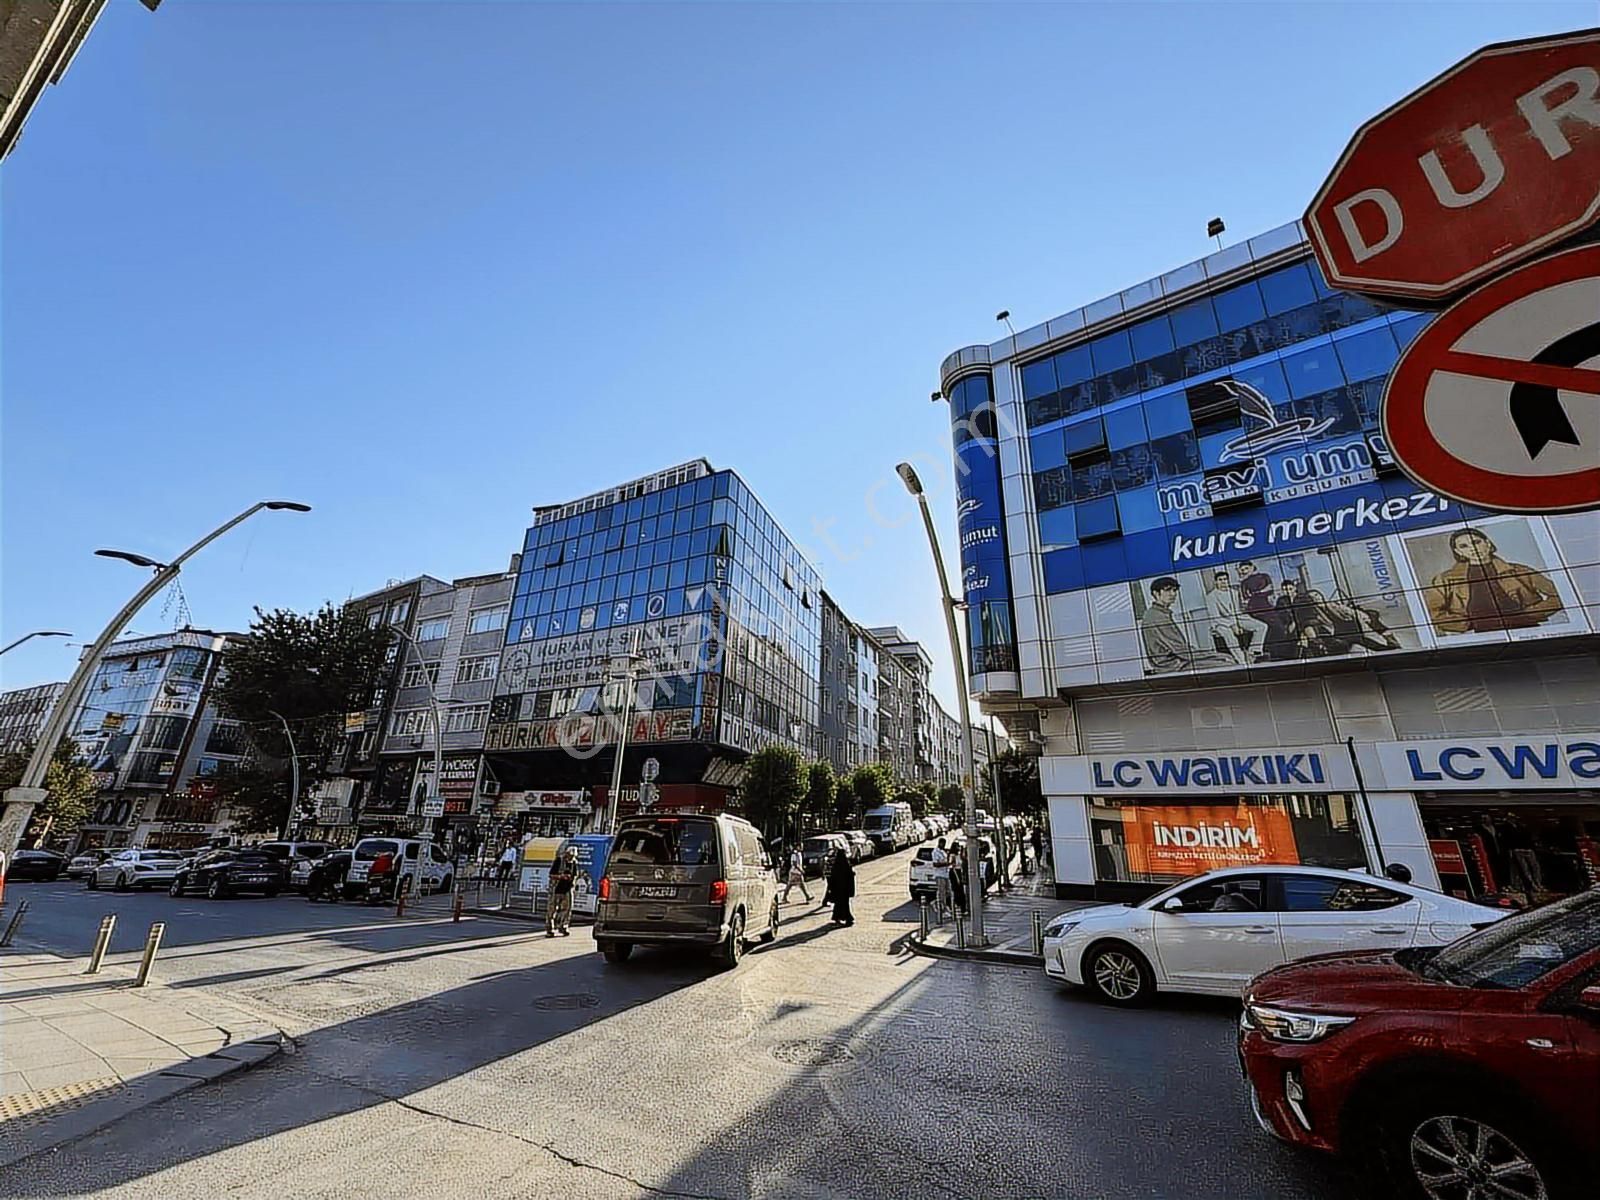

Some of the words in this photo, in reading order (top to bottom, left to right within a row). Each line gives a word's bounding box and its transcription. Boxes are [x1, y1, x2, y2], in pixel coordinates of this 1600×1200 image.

[1333, 66, 1600, 264] DUR
[1157, 458, 1271, 513] mavi
[962, 526, 998, 545] umut
[1172, 527, 1255, 562] kurs
[488, 721, 544, 749] TÜRK
[546, 712, 671, 747] KIZIAY
[1092, 760, 1142, 788] LC
[1406, 747, 1485, 781] LC
[1153, 820, 1260, 849] İNDİRİM
